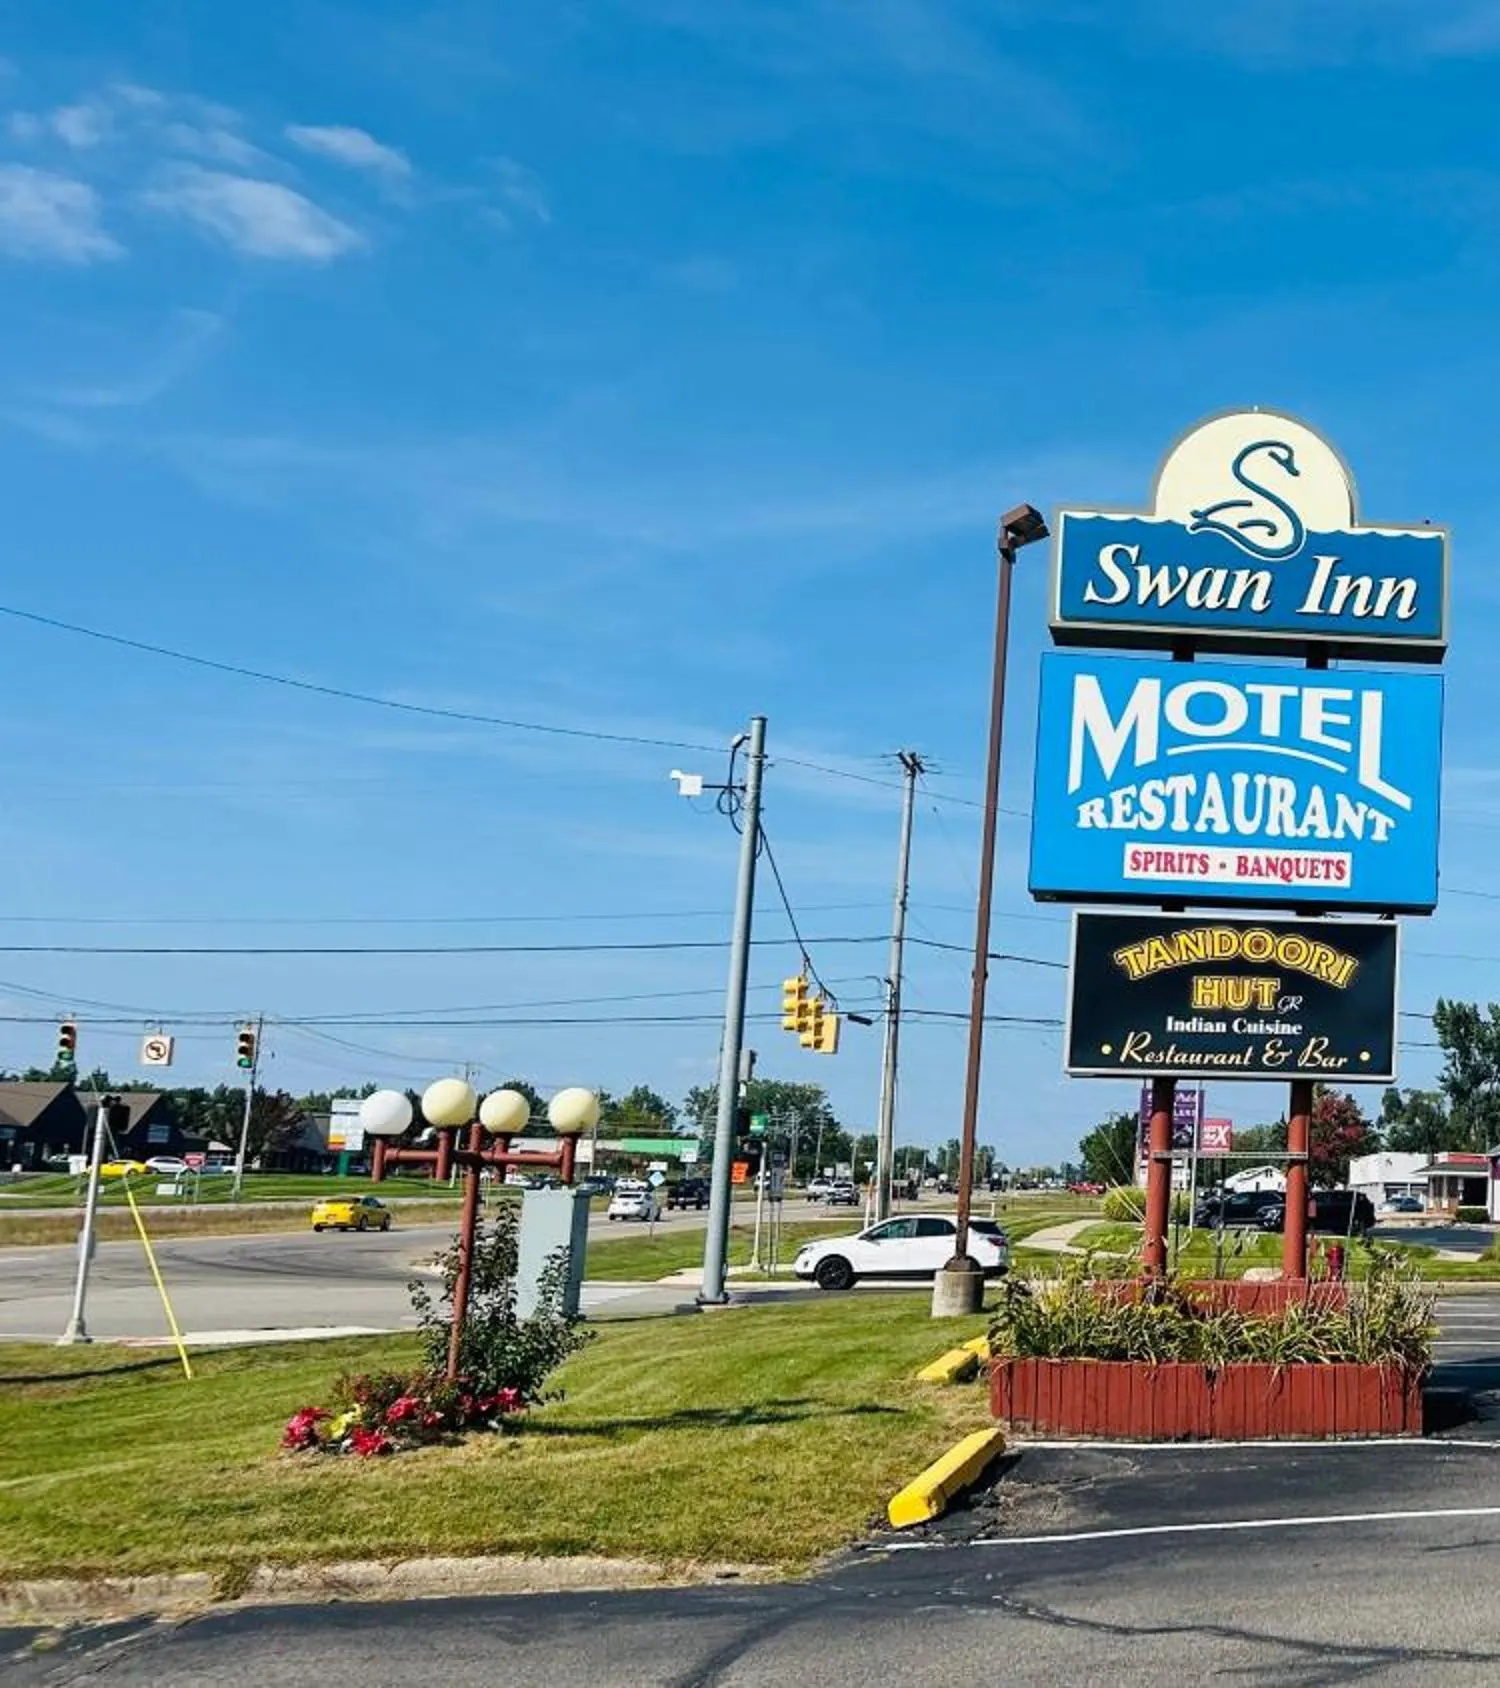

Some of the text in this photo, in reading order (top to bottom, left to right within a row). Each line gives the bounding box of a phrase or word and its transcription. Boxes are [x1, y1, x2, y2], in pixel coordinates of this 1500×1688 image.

[1084, 544, 1417, 619] Swan Inn
[1068, 674, 1412, 812] MOTEL
[1077, 772, 1396, 842] RESTAURANT
[1130, 850, 1347, 882] SPIRITS BANQUETS
[1114, 926, 1359, 989] TANDOORI
[1191, 975, 1280, 1010] HUT
[1119, 1031, 1348, 1068] Restaurant & Bar
[1166, 1015, 1303, 1036] Indian Cuisine
